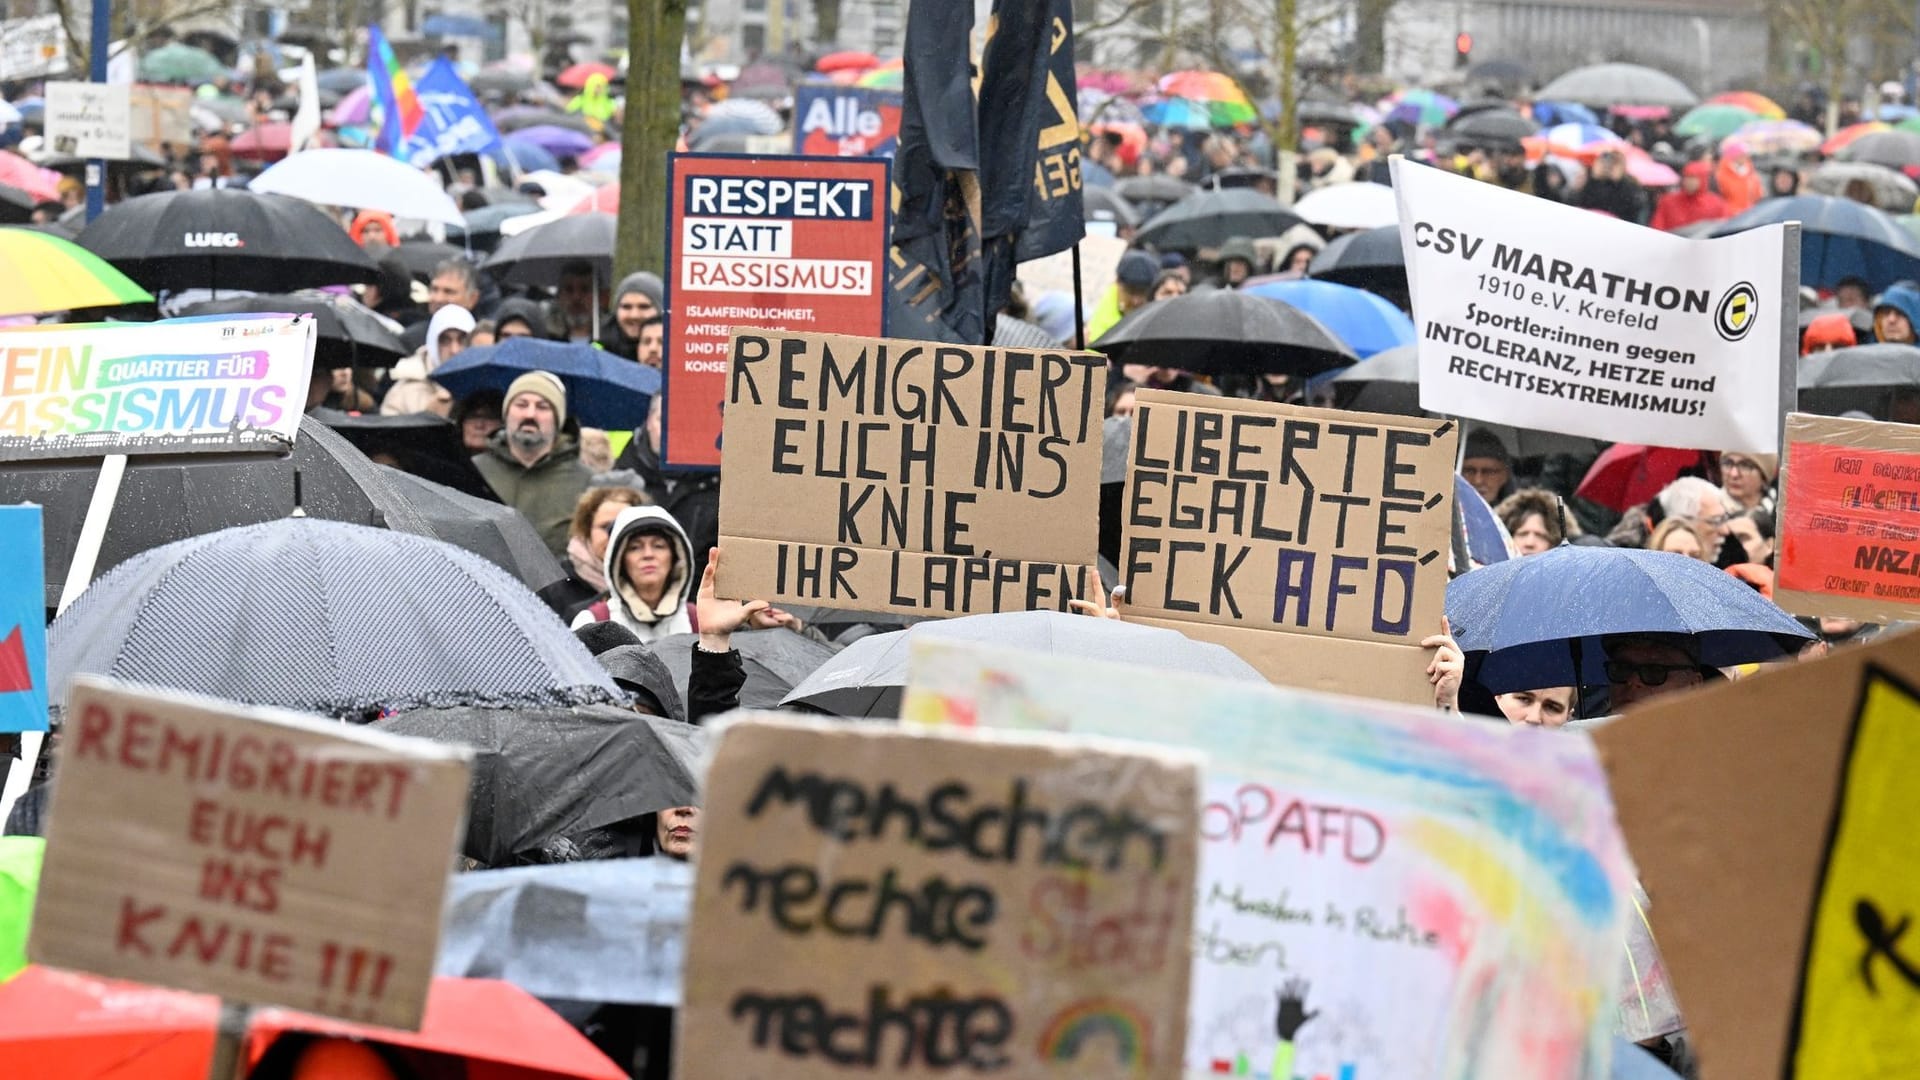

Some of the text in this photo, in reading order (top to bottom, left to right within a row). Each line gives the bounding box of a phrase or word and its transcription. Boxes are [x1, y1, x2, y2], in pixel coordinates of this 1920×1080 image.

[802, 97, 882, 137] Alle
[691, 178, 869, 217] RESPEKT
[690, 223, 783, 252] STATT
[689, 261, 865, 290] RASSISMUS!
[1414, 222, 1711, 314] CSV MARATHON
[686, 306, 817, 323] ISLAMFEINDLICHKEIT,
[1477, 273, 1659, 331] 1910 e.V. Krefeld
[685, 343, 728, 355] UND FR
[1426, 321, 1716, 393] INTOLERANZ, HETZE und
[1466, 303, 1696, 366] Sportler:innen gegen
[0, 345, 93, 397] EIN
[108, 355, 256, 381] QUARTIER FÜR
[685, 361, 727, 373] KONSE
[731, 336, 1107, 442] REMIGRIERT
[1448, 355, 1707, 417] RECHTSEXTREMISMUS!
[772, 418, 1070, 498] EUCH INS
[1834, 457, 1862, 475] ICH
[838, 482, 991, 558] KNIE,
[776, 544, 1086, 614] IHR LAPPEN
[1125, 537, 1251, 619] FCK
[1825, 575, 1870, 593] NICHT
[1854, 546, 1920, 577] NAZI
[76, 703, 411, 821] REMIGRIERT
[187, 797, 331, 867] EUCH
[198, 857, 282, 912] INS
[721, 861, 999, 952] rechte
[732, 984, 1013, 1070] rechte
